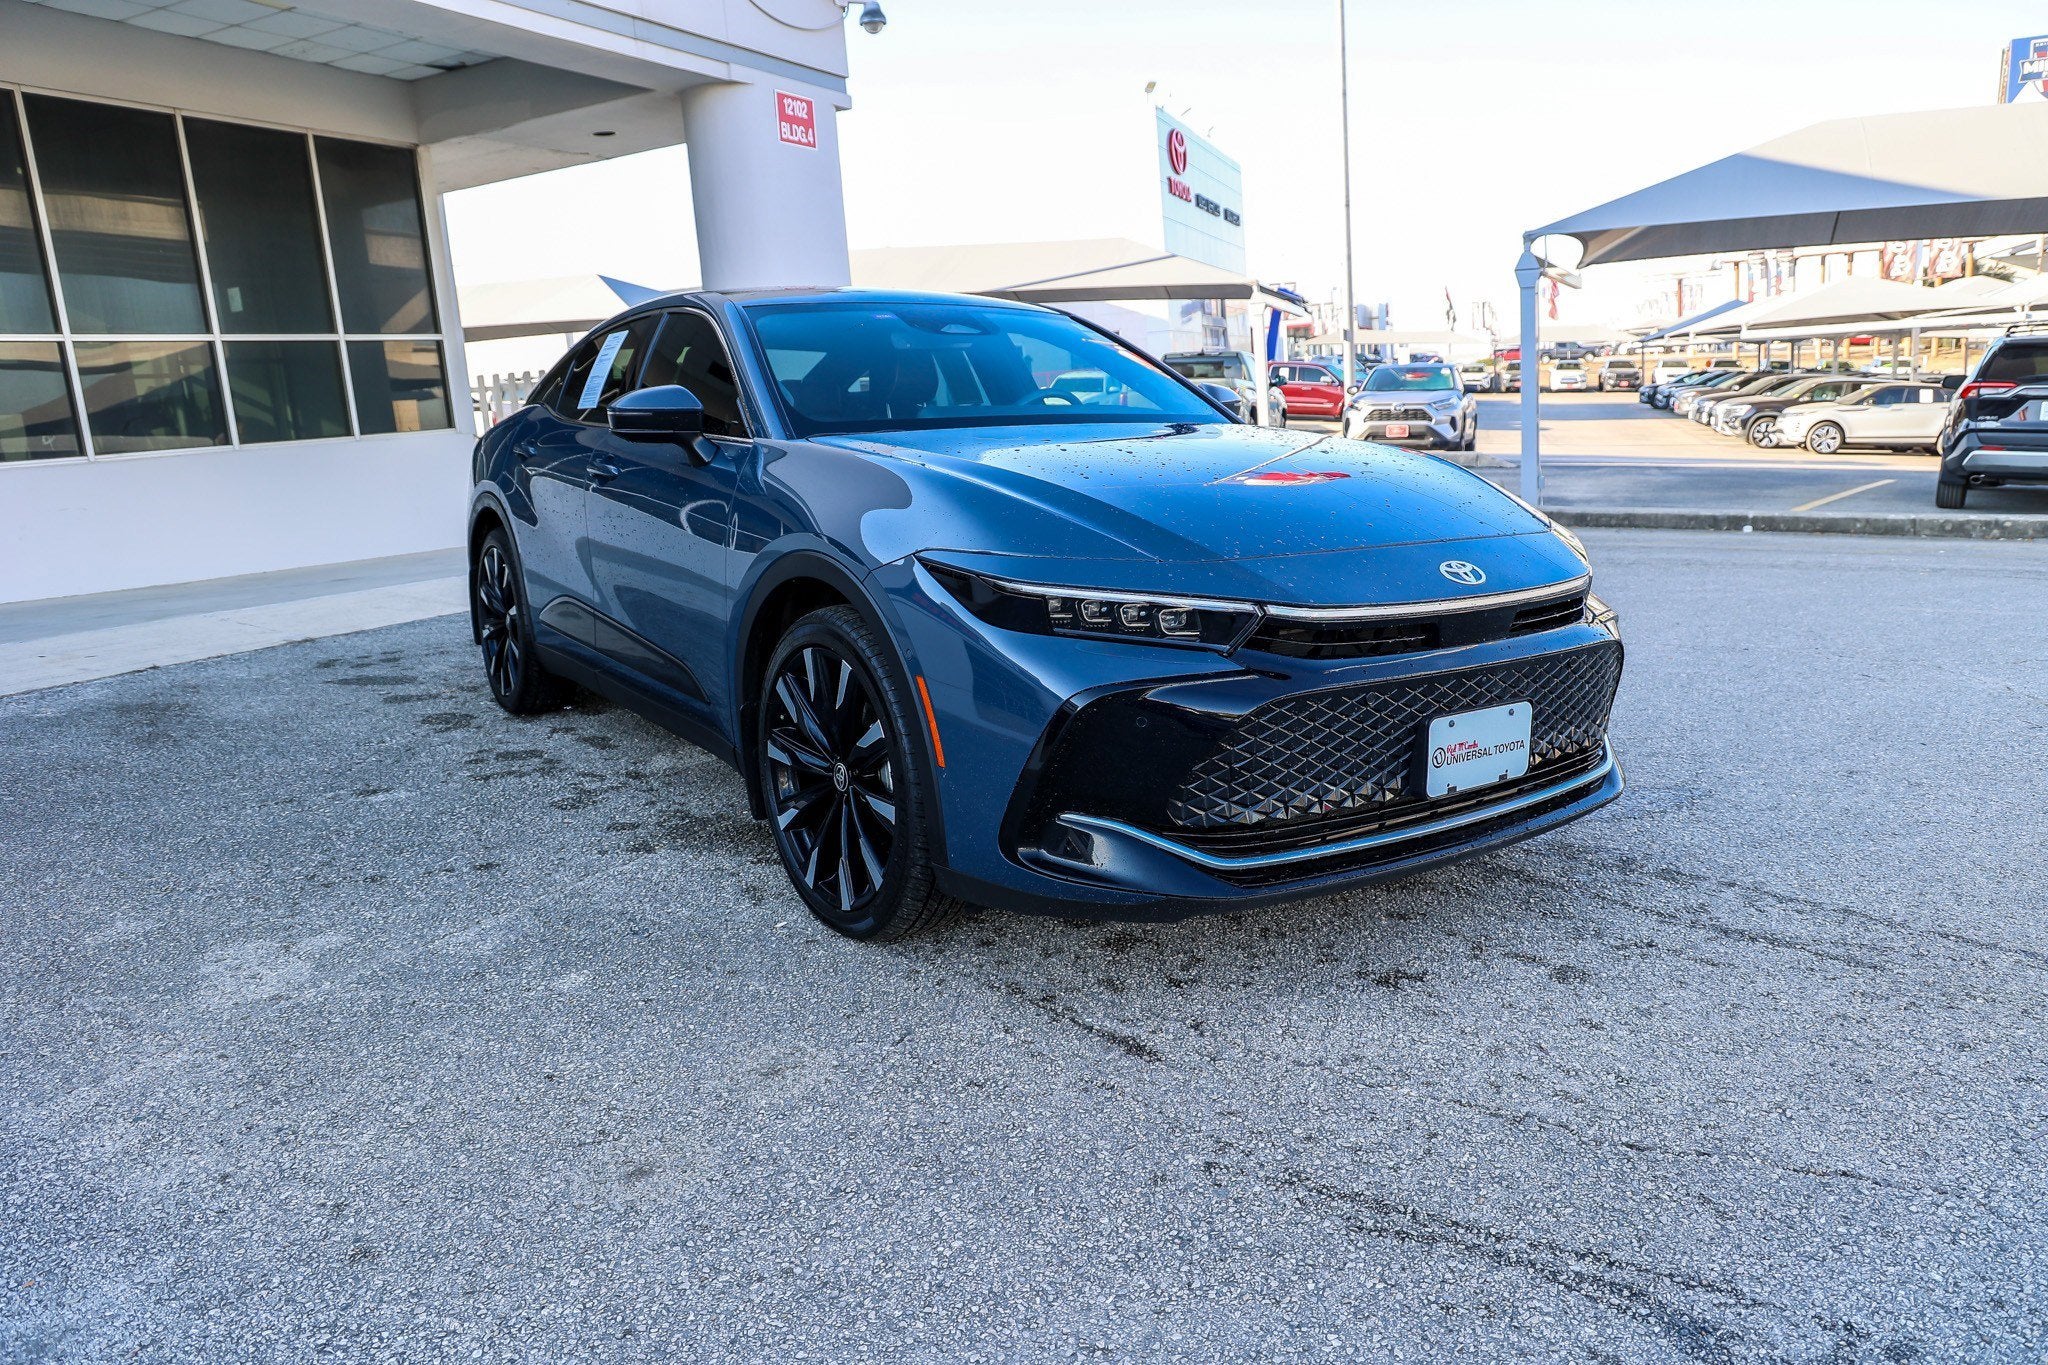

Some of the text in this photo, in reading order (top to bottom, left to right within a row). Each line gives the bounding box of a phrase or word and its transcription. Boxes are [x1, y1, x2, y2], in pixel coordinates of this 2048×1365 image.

[783, 97, 808, 119] 12102
[807, 128, 814, 144] 4
[1446, 740, 1525, 765] UNIVERSAL TOYOTA
